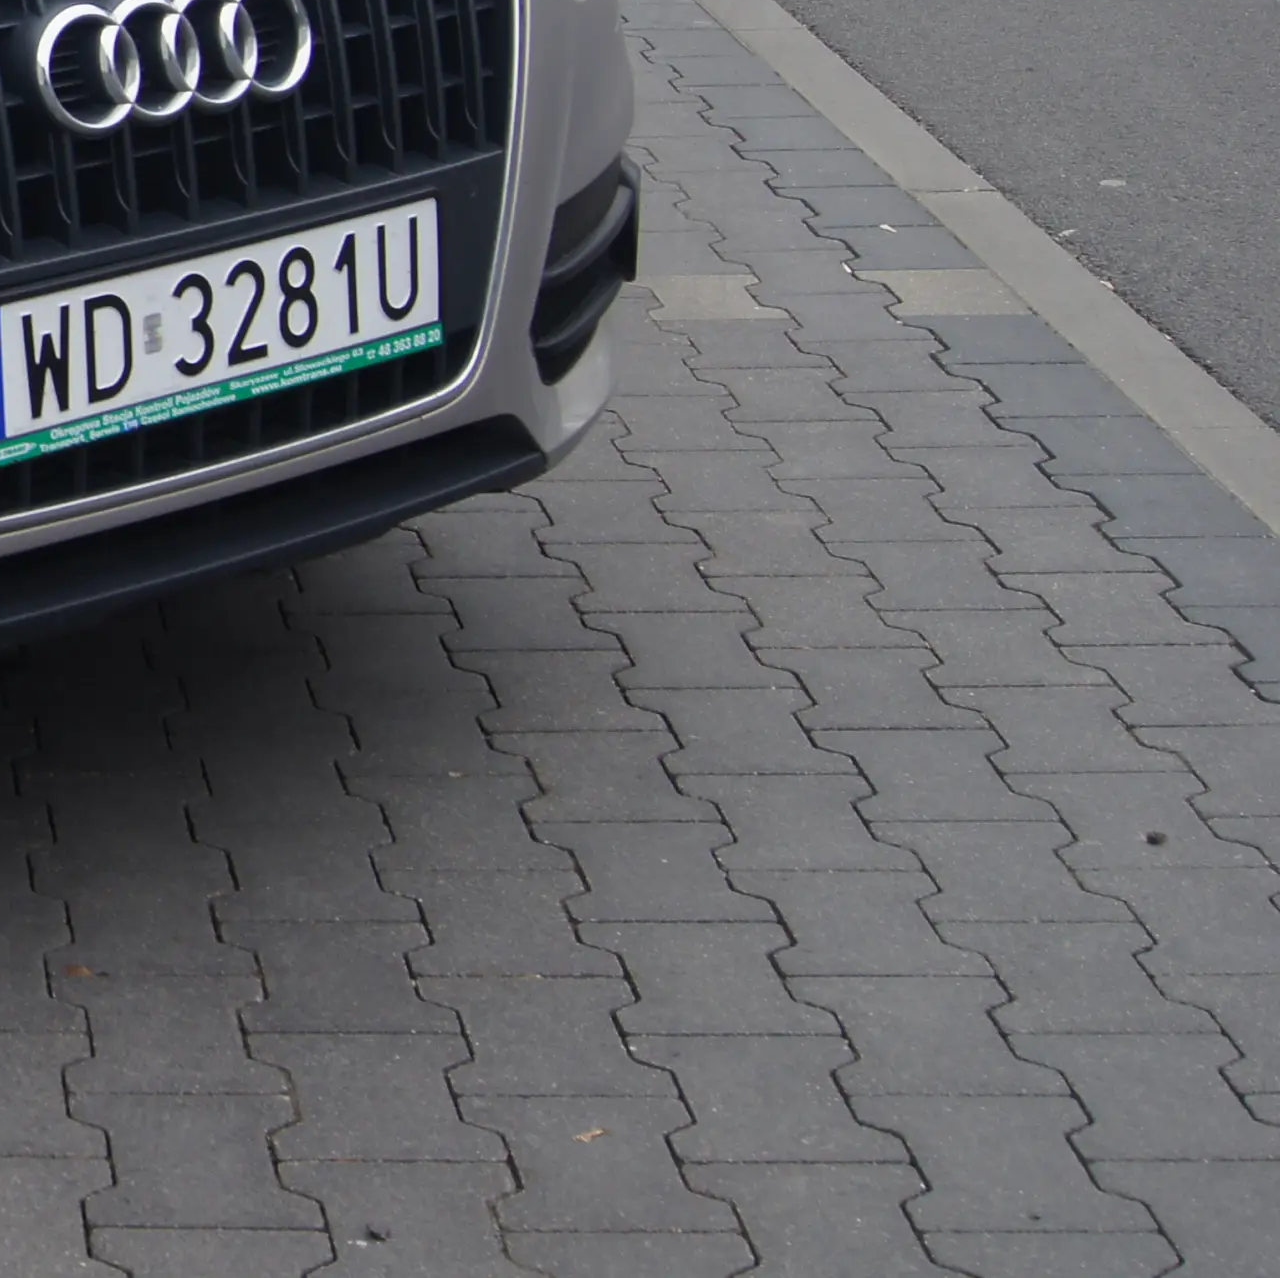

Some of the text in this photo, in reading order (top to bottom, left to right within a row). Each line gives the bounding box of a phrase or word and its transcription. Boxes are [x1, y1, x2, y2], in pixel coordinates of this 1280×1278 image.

[21, 216, 419, 420] WD 3281U
[378, 342, 392, 356] 48
[428, 328, 441, 343] 20
